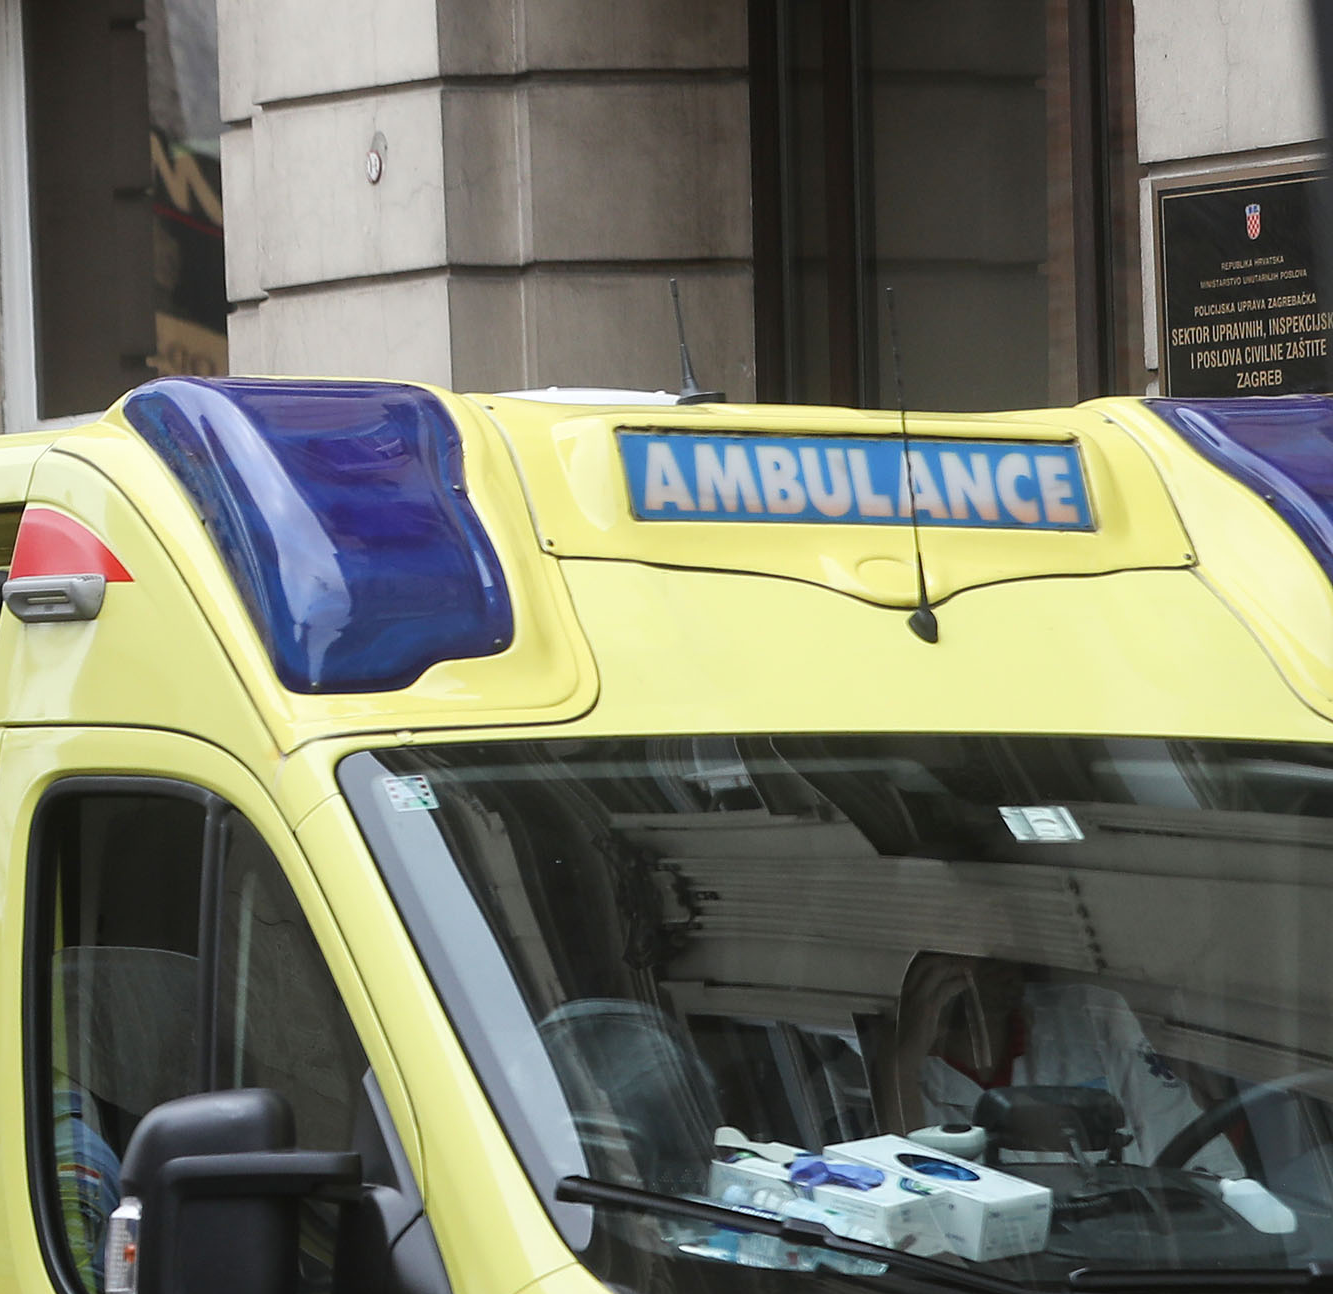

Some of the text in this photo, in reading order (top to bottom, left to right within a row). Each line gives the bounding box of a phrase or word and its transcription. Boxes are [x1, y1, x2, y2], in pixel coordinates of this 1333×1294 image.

[1221, 256, 1284, 271] REPUBLIKA HRVATSKA
[1280, 269, 1307, 280] POSLOVA
[1194, 291, 1317, 317] POLICIJSKA UPRAVA ZAGREBAČKA
[1172, 326, 1210, 347] SEKTOR
[1212, 320, 1267, 342] UPRAVNIH,
[1190, 337, 1327, 370] I POSLOVA CIVILNE ZAŠTITE
[1236, 369, 1283, 389] ZAGREB
[643, 441, 1081, 524] AMBULANCE
